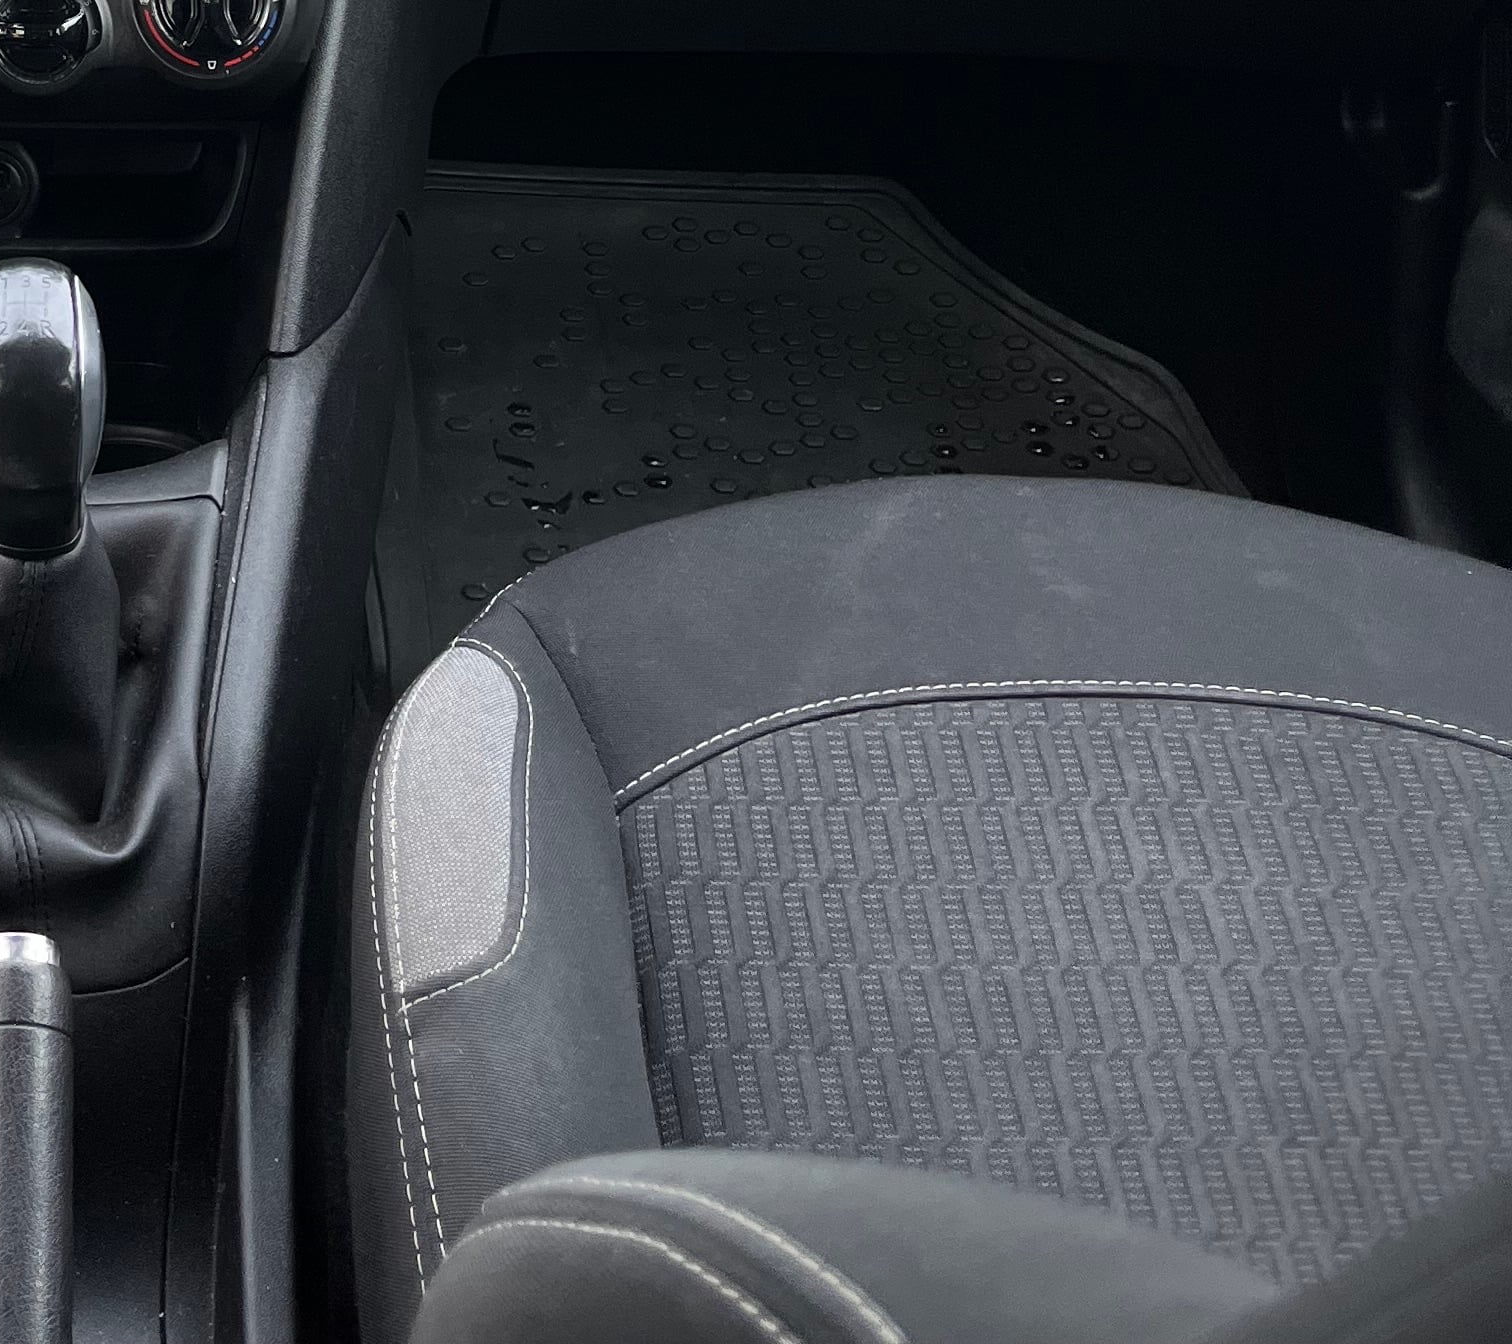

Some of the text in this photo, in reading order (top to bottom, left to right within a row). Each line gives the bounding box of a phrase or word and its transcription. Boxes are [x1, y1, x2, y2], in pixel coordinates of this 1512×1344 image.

[22, 275, 31, 288] 3
[41, 275, 51, 289] 5
[0, 320, 56, 339] 2 4 R
